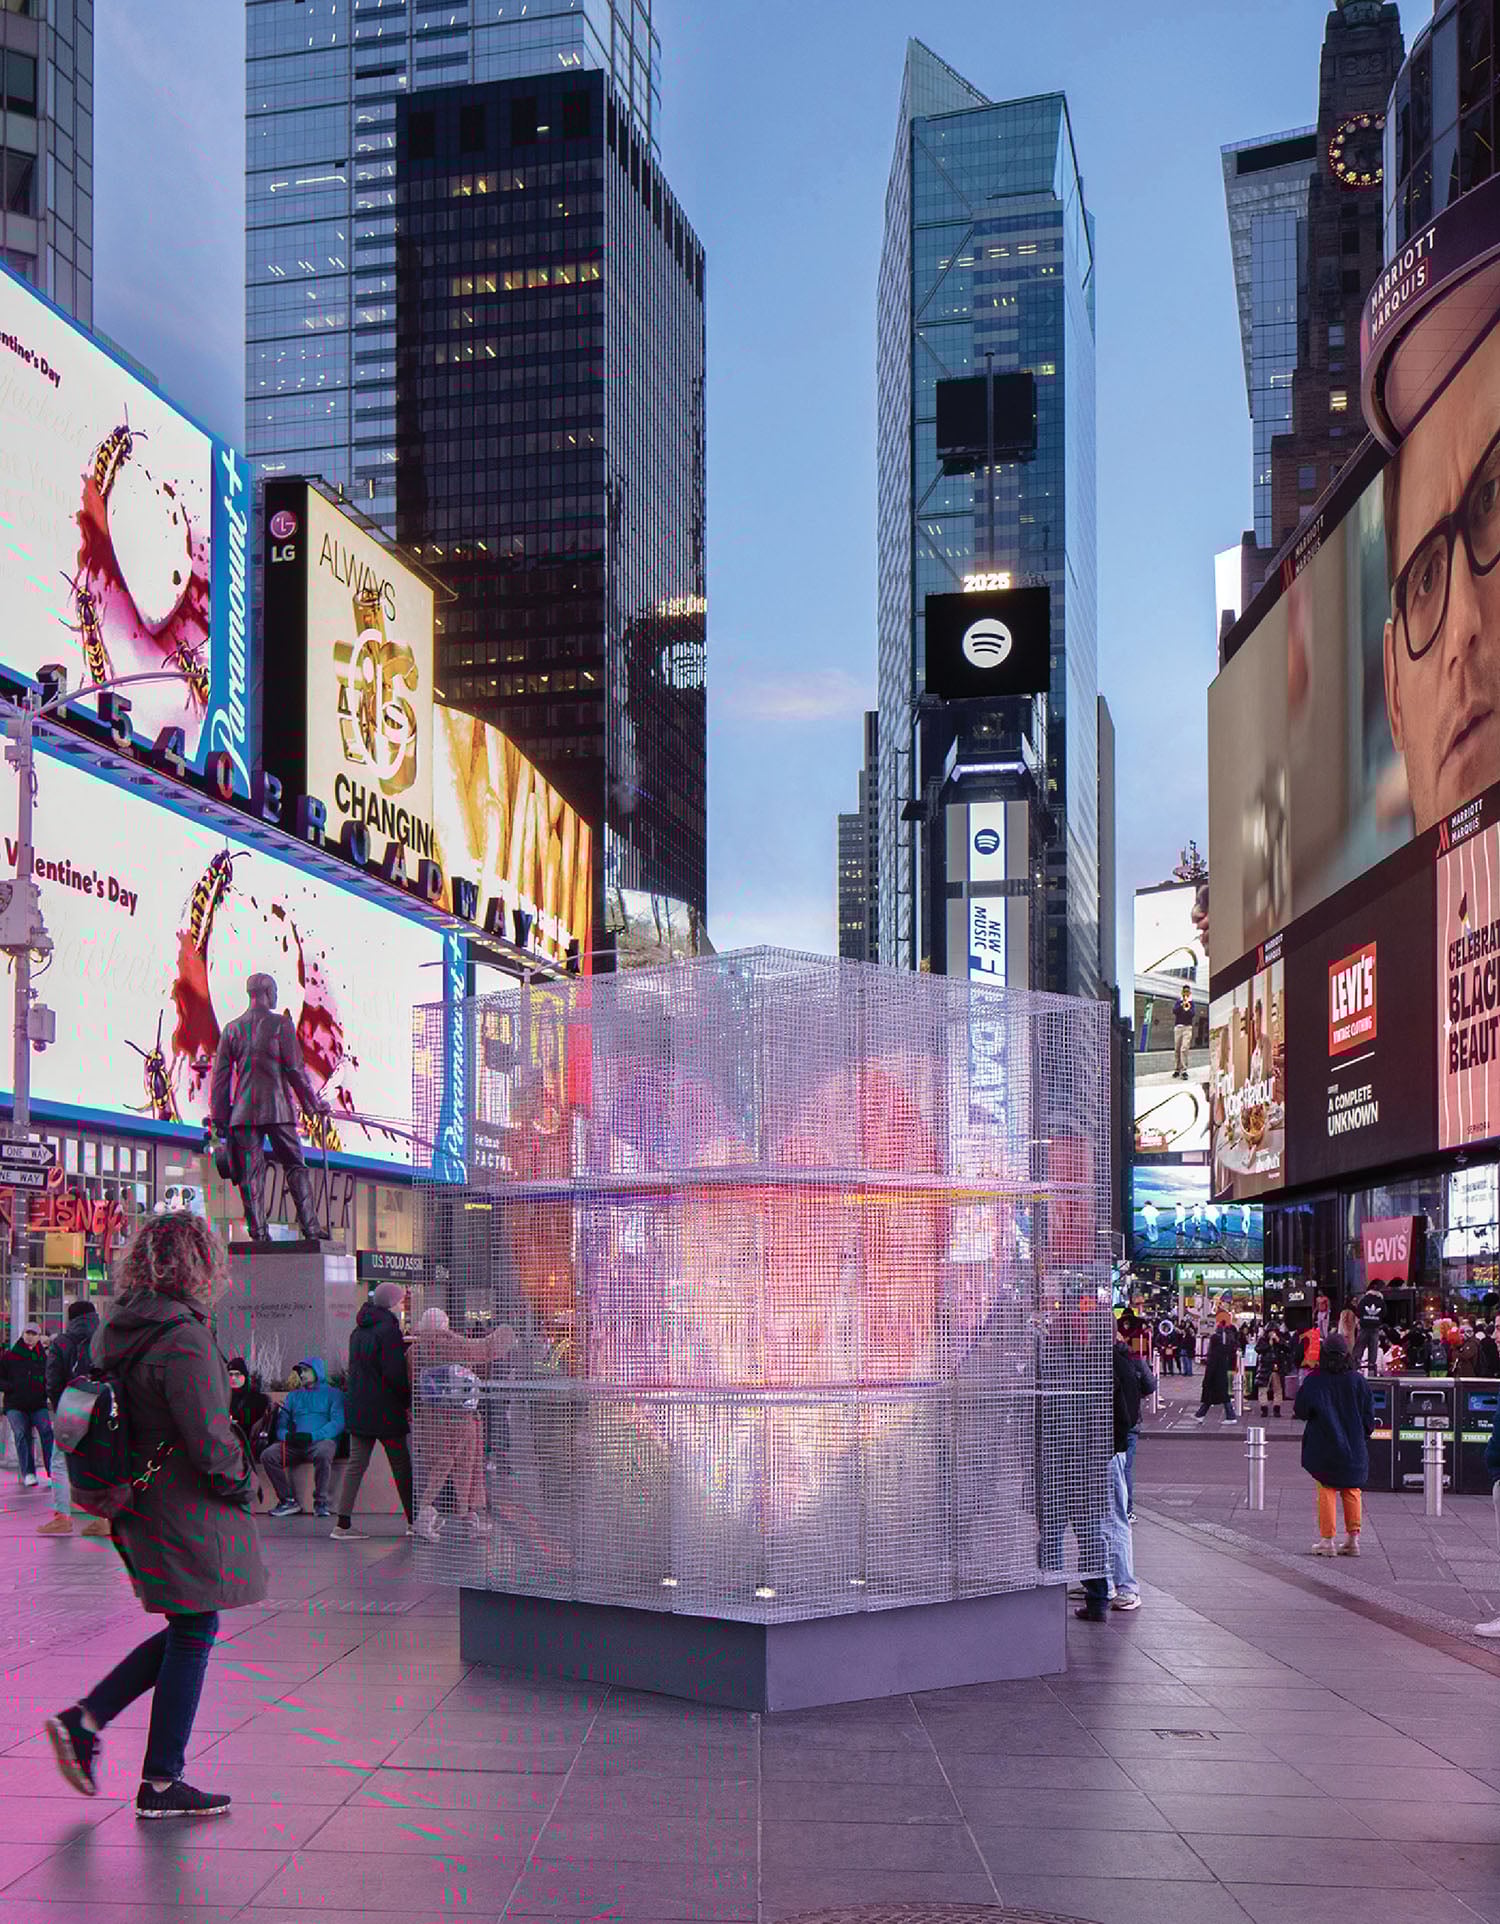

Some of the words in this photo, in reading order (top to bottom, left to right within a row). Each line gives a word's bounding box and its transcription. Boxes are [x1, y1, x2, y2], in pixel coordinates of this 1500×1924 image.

[1372, 227, 1436, 314] MARRIOTT
[1372, 265, 1425, 340] MARQUIS
[0, 331, 39, 368] ntine's
[40, 357, 61, 388] Day
[271, 545, 296, 563] LG
[320, 533, 396, 622] ALWAYS
[963, 573, 1011, 593] 2025
[1451, 798, 1482, 828] MARRIOTT
[1451, 817, 1480, 843] MARQUIS
[4, 837, 105, 899] Vlentine's
[108, 876, 138, 916] Day
[251, 768, 533, 949] BROADWAY
[974, 905, 987, 950] MUSIC
[989, 920, 1001, 954] NEW
[1332, 954, 1374, 1024] LEVI'S
[1327, 1097, 1334, 1113] A
[1335, 1084, 1373, 1109] COMPLETE
[1328, 1101, 1379, 1137] UNKNOWN
[6, 1146, 25, 1157] ONE
[31, 1149, 48, 1160] WAY
[20, 1170, 41, 1184] WAY
